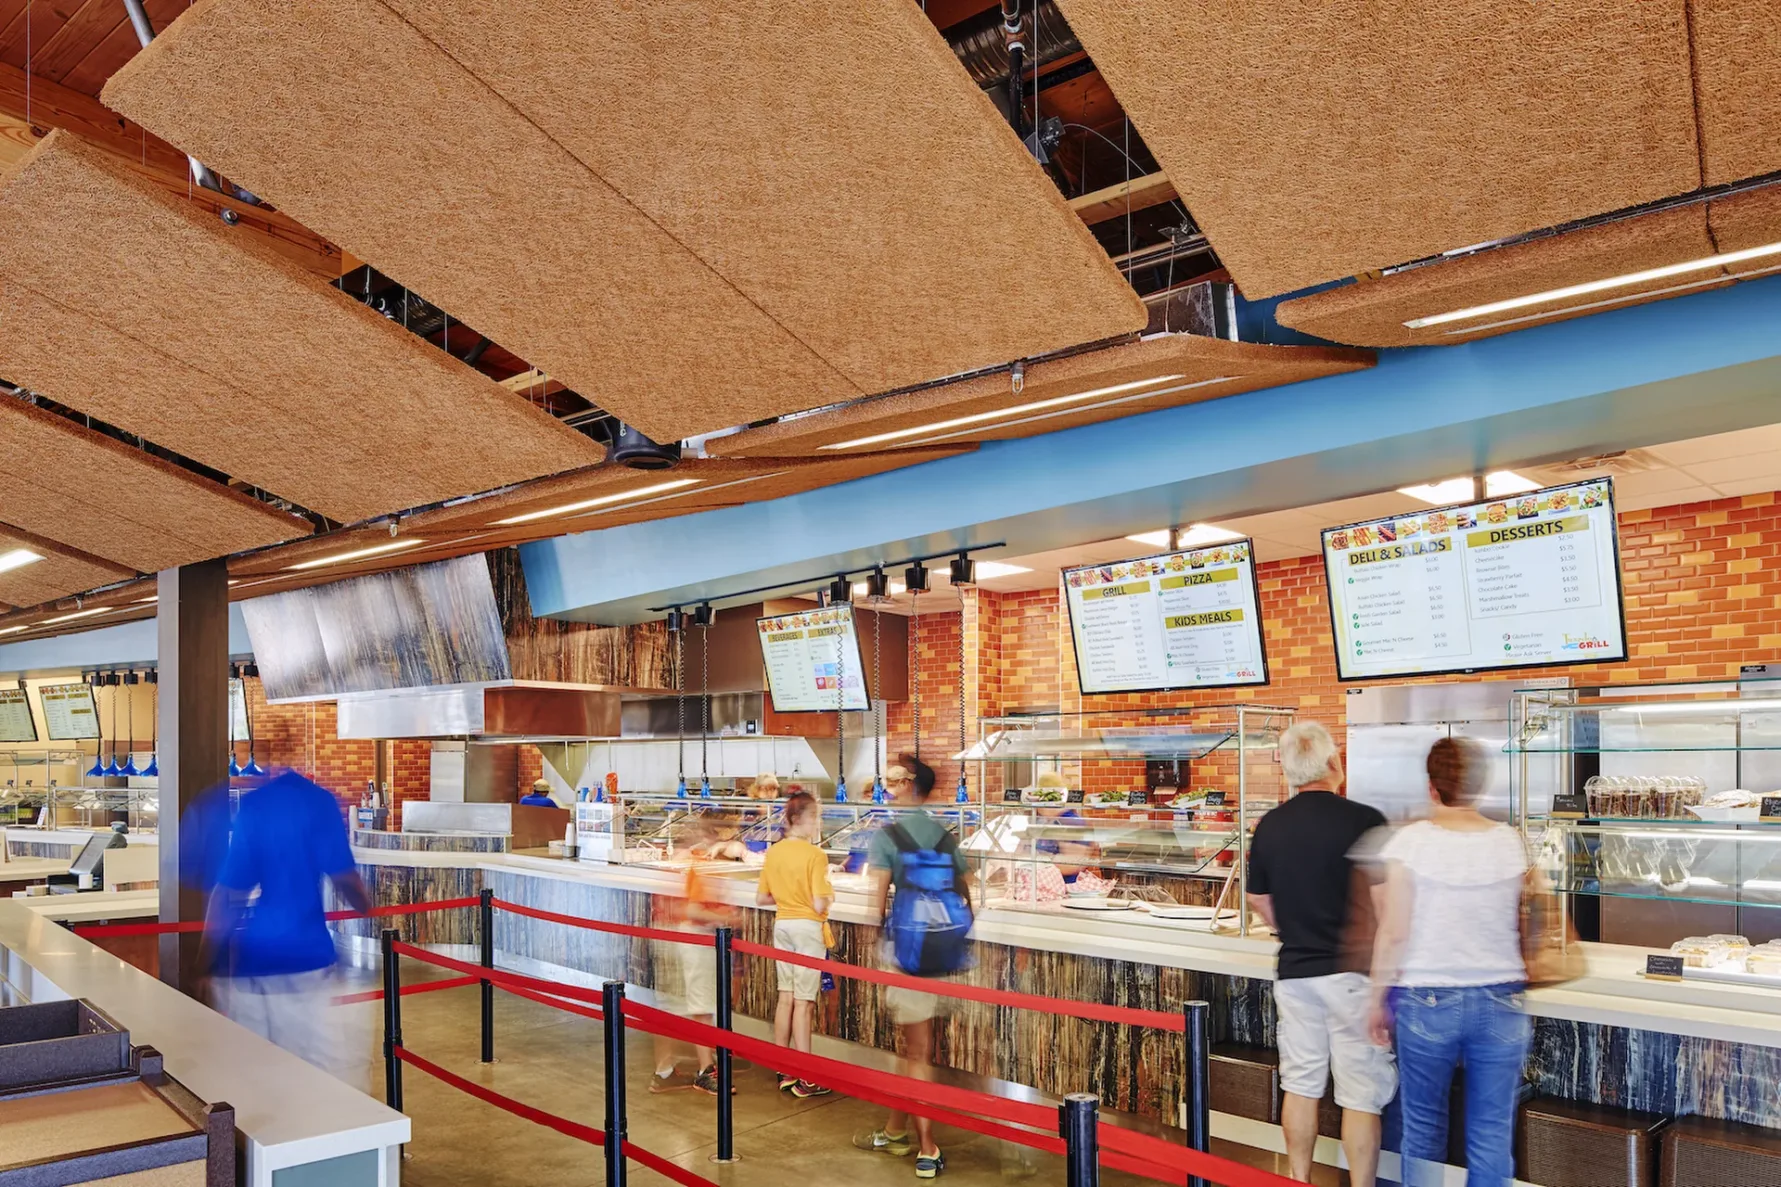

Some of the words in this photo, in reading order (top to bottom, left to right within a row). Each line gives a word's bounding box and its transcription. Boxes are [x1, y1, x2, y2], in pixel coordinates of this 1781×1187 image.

[1490, 520, 1563, 543] DESSERTS
[1350, 551, 1376, 565] DELI
[1380, 549, 1390, 560] &
[1394, 540, 1446, 558] SALADS
[1184, 573, 1213, 586] PIZZA
[1103, 586, 1127, 597] GRILL
[1174, 616, 1197, 627] KIDS
[1200, 611, 1232, 624] MEALS
